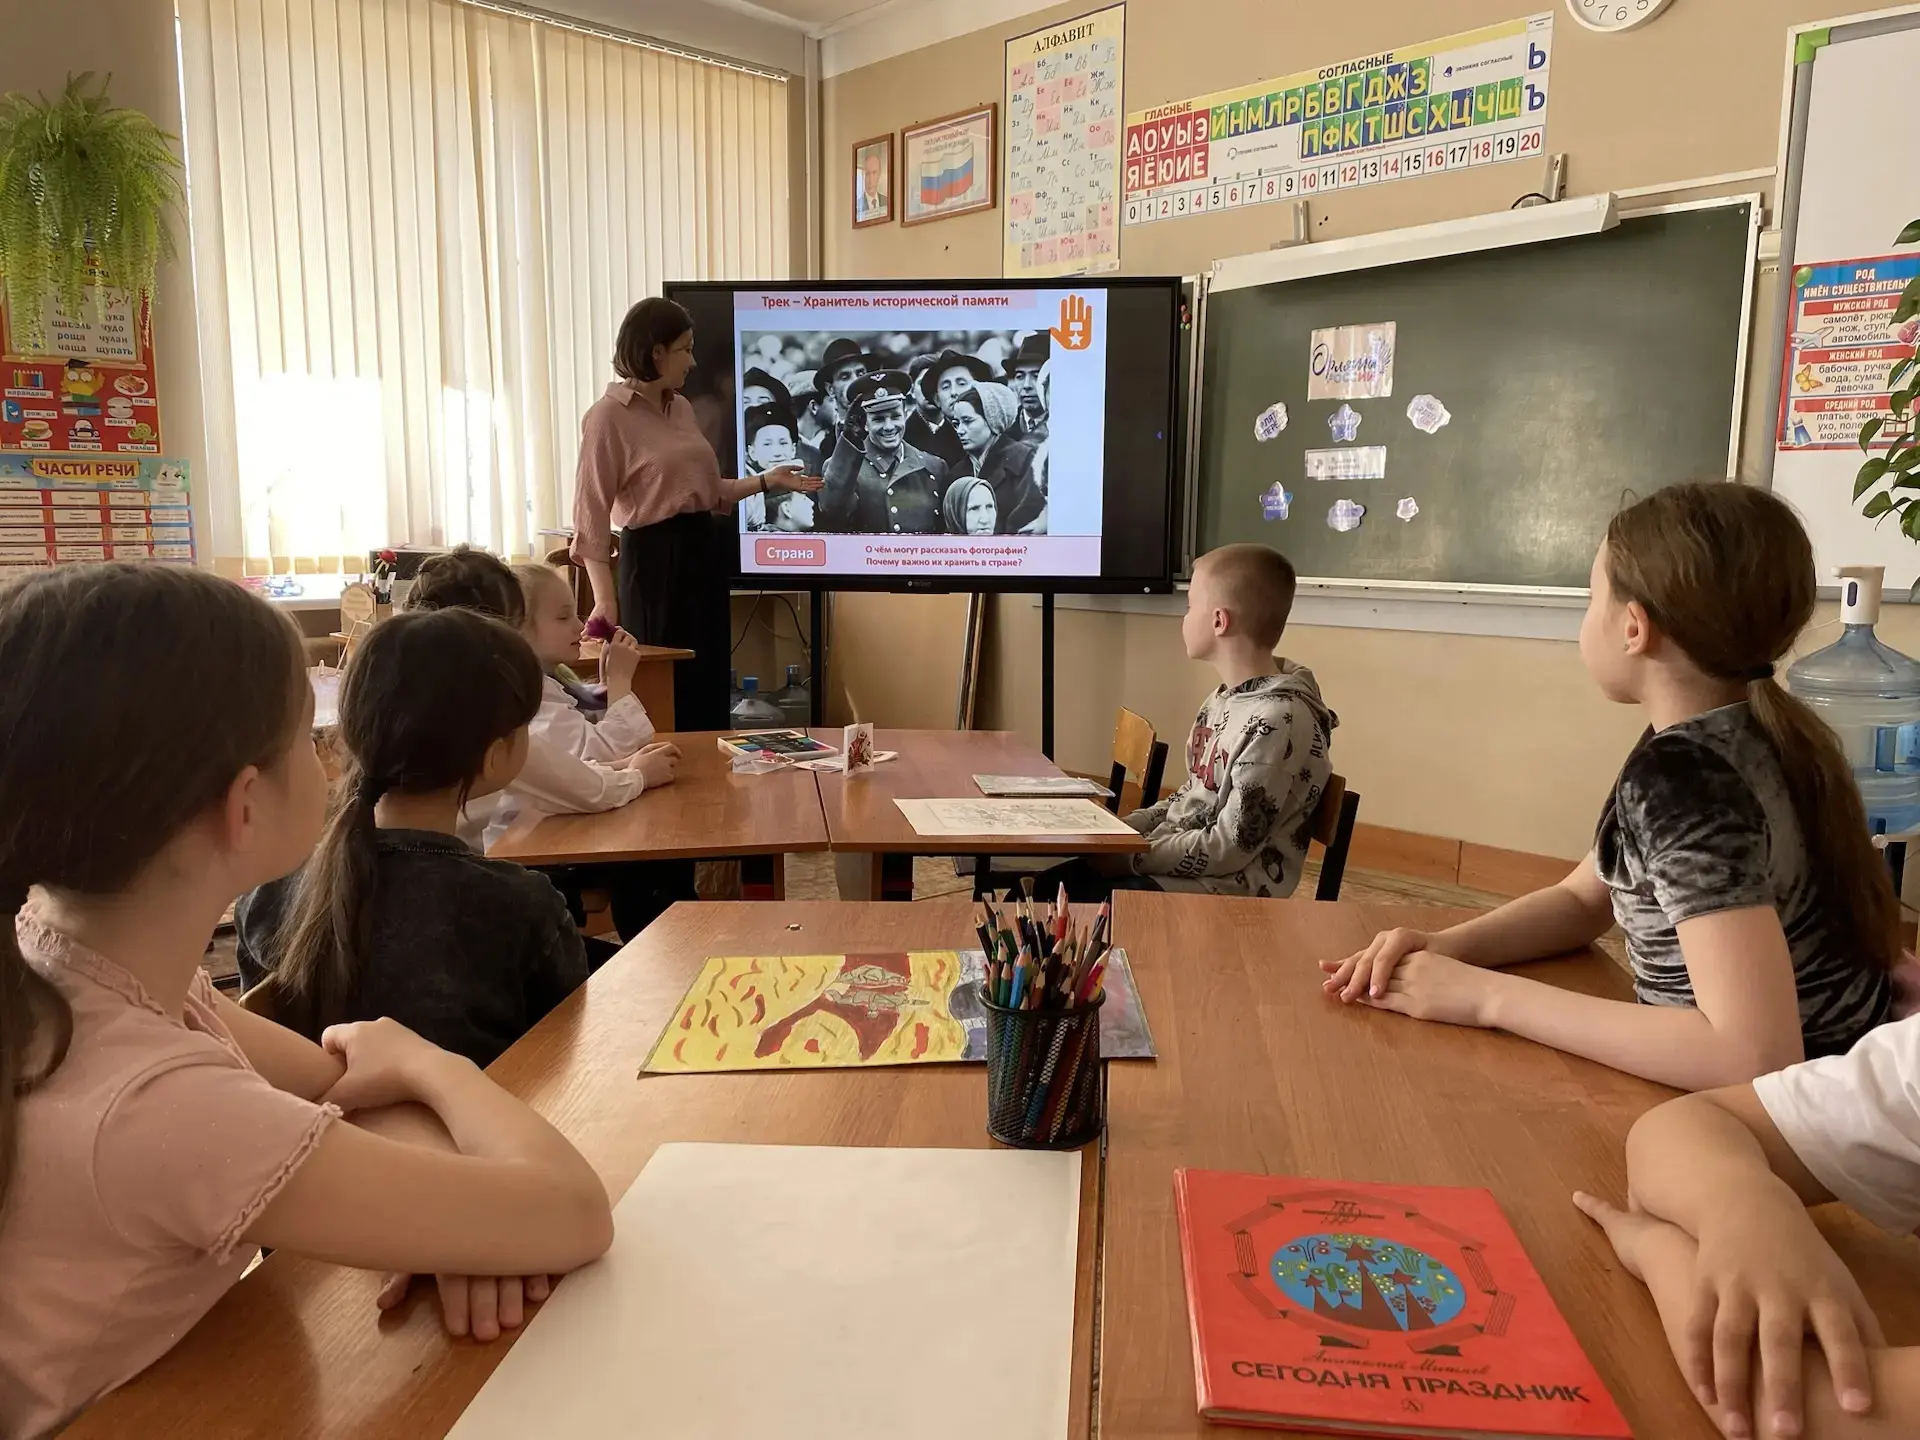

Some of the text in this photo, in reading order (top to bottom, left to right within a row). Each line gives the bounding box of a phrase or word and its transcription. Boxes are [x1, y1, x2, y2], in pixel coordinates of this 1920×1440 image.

[1598, 5, 1608, 20] 7
[1616, 7, 1627, 20] 6
[1033, 23, 1094, 53] АЛФАВИТ
[1480, 55, 1513, 66] СОГЛАСНЫЕ
[1529, 42, 1546, 70] Ь
[1318, 53, 1394, 80] СОГЛАСНЫЕ
[1212, 68, 1426, 140] Й Н М Л Р Б В Г Д Ж З
[1525, 84, 1545, 111] Ъ
[1145, 102, 1192, 121] ГЛАСНЫЕ
[1303, 87, 1520, 155] П Ф К Т Ш С Х Ц Ч Щ
[1128, 118, 1207, 156] А О У Ы Э
[1356, 145, 1386, 153] СОГЛАСНЫЕ
[1128, 166, 1139, 189] Я
[1145, 156, 1155, 185] Ё
[1159, 158, 1173, 182] Ю
[1176, 155, 1189, 179] И
[1194, 152, 1205, 175] Е
[1130, 207, 1135, 219] 0
[1146, 204, 1151, 216] 1
[1162, 201, 1168, 214] 2
[1179, 198, 1184, 210] 3
[1195, 194, 1202, 207] 4
[1213, 191, 1219, 204] 5
[1230, 188, 1237, 201] 6
[1249, 185, 1255, 198] 7
[1267, 182, 1274, 195] 8
[1286, 178, 1292, 191] 9
[1302, 173, 1316, 191] 10
[1322, 170, 1335, 185] 11
[1342, 166, 1356, 182] 12
[1362, 162, 1378, 178] 13
[1383, 158, 1399, 175] 14
[1405, 155, 1421, 171] 15
[1427, 150, 1443, 167] 16
[1450, 146, 1467, 163] 17
[1473, 142, 1490, 159] 18
[1497, 137, 1515, 155] 19
[1521, 132, 1540, 150] 20
[1856, 268, 1874, 280] РОД
[1804, 284, 1828, 298] ИМЁН
[762, 296, 789, 307] Трек
[804, 296, 869, 307] Хранитель
[873, 295, 958, 308] исторической
[962, 296, 1008, 306] памяти
[1833, 298, 1888, 311] МУЖСКОЙ РОД
[1823, 313, 1866, 324] самолёт,
[1839, 324, 1860, 333] нож,
[58, 332, 85, 342] роща
[100, 334, 128, 344] чулан
[1832, 331, 1890, 343] автомобиль
[58, 344, 86, 353] чаща
[96, 347, 133, 356] щупать
[1829, 349, 1882, 361] ЖЕНСКИЙ РОД
[1819, 364, 1860, 374] бабочка,
[1825, 373, 1885, 384] вода, сумка,
[1834, 384, 1873, 393] девочка
[1825, 397, 1875, 410] СРЕДНИЙ РОД
[1817, 411, 1880, 421] платье, окно,
[1818, 421, 1864, 432] ухо, поле
[38, 463, 134, 476] ЧАСТИ РЕЧИ
[767, 547, 814, 561] Страна
[875, 545, 891, 553] чём
[894, 546, 918, 556] могут
[920, 546, 967, 556] рассказать
[969, 545, 1028, 556] фотографии?
[866, 558, 899, 568] Почему
[944, 558, 980, 568] хранить
[989, 558, 1022, 568] стране?
[1230, 1359, 1590, 1403] СЕГОДНЯ ПРАЗДНИК
